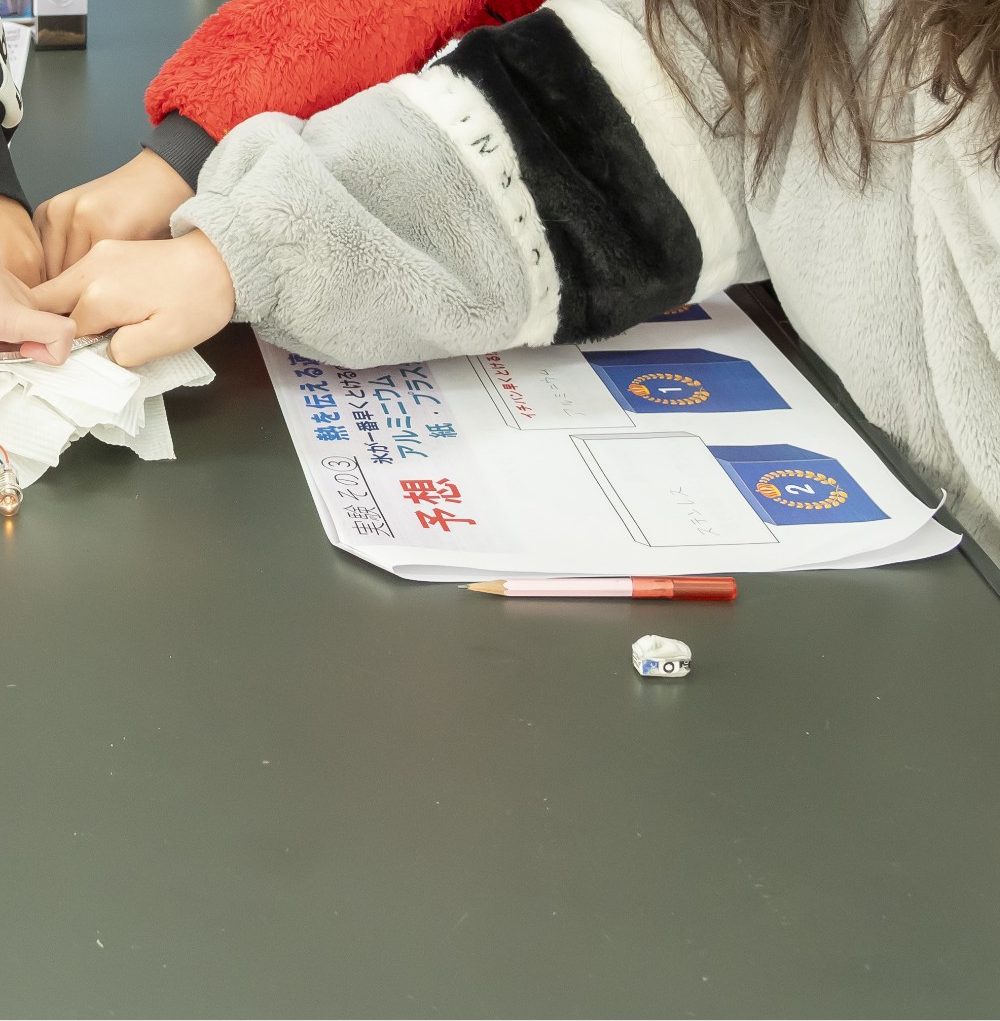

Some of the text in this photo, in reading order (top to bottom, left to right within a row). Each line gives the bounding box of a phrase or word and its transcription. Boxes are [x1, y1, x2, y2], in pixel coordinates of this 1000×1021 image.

[657, 386, 684, 395] 1
[784, 484, 817, 494] 2
[399, 478, 476, 532] 予想
